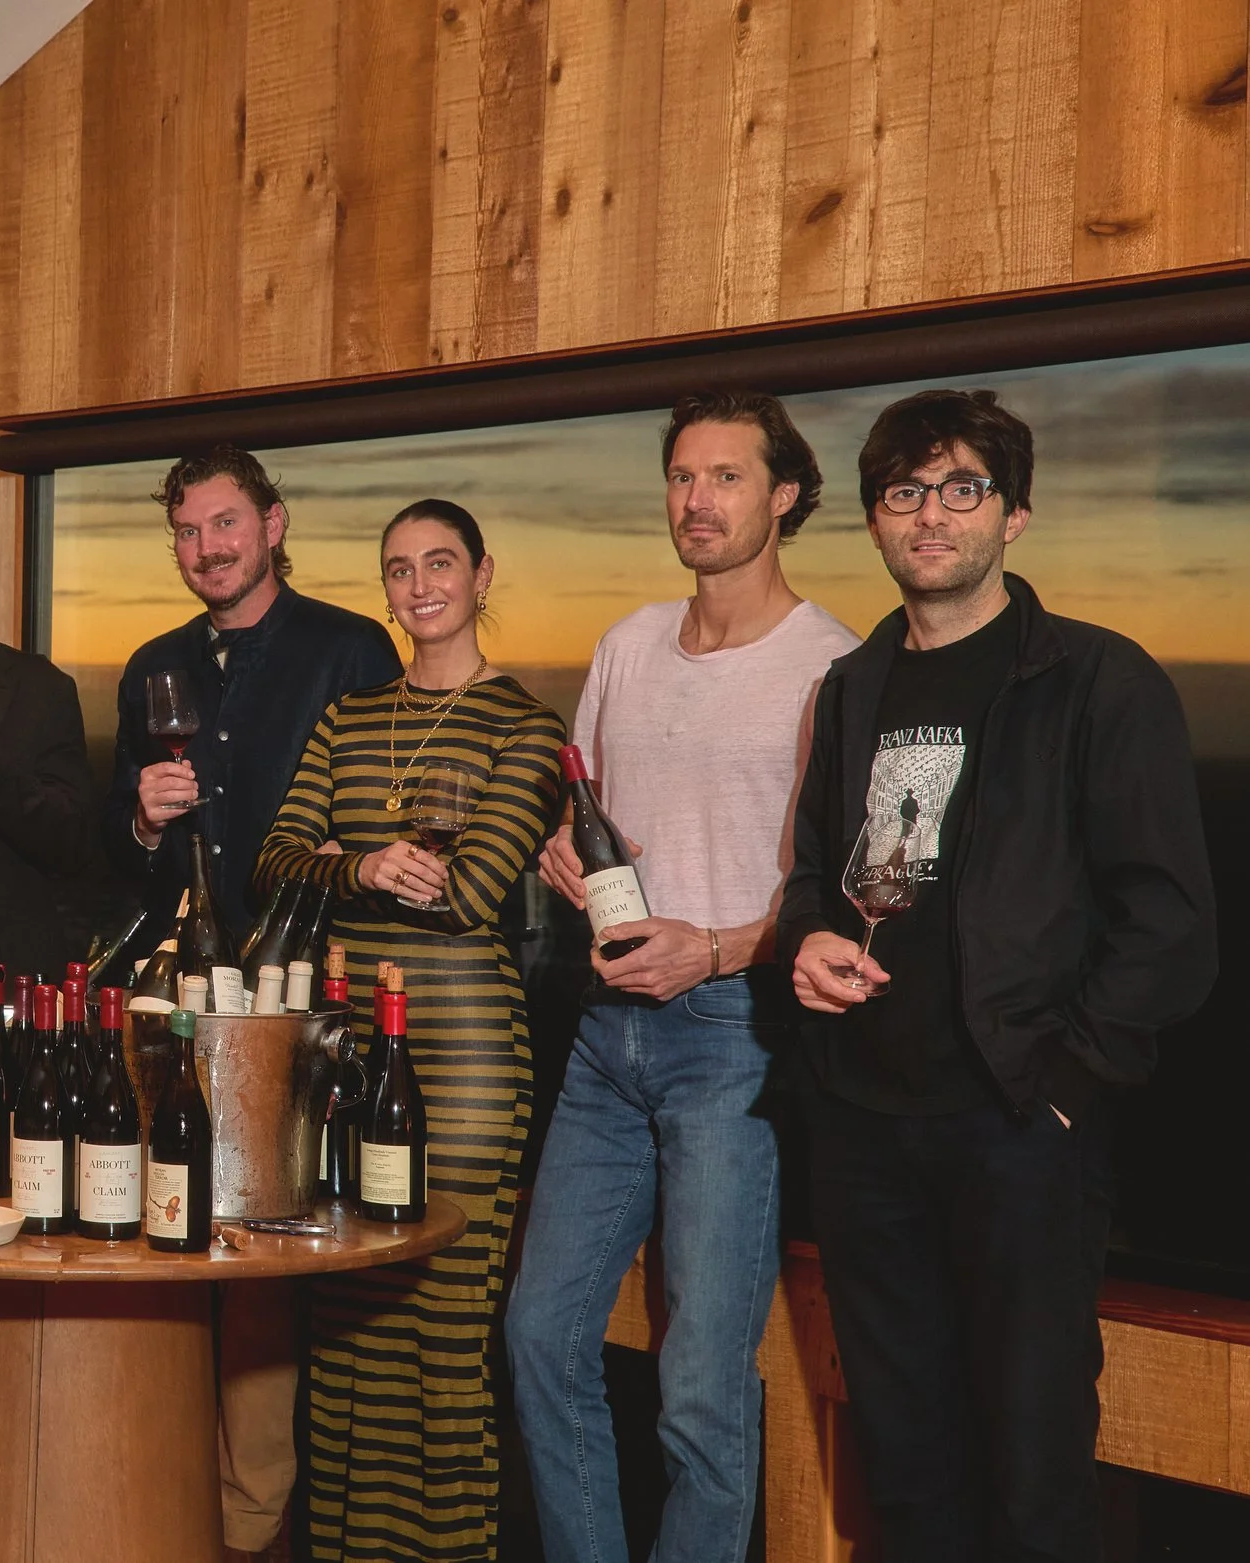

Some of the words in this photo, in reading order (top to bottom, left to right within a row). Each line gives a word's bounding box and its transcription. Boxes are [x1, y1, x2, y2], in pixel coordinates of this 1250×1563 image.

[878, 728, 915, 751] FRANZ
[916, 725, 964, 744] KAFKA
[867, 861, 928, 880] PRAGUE
[588, 879, 625, 898] ABBOTT
[597, 903, 629, 920] CLAIM
[89, 1159, 131, 1170] ABBOTT
[13, 1180, 41, 1191] CLAIM
[93, 1187, 128, 1196] CLAIM
